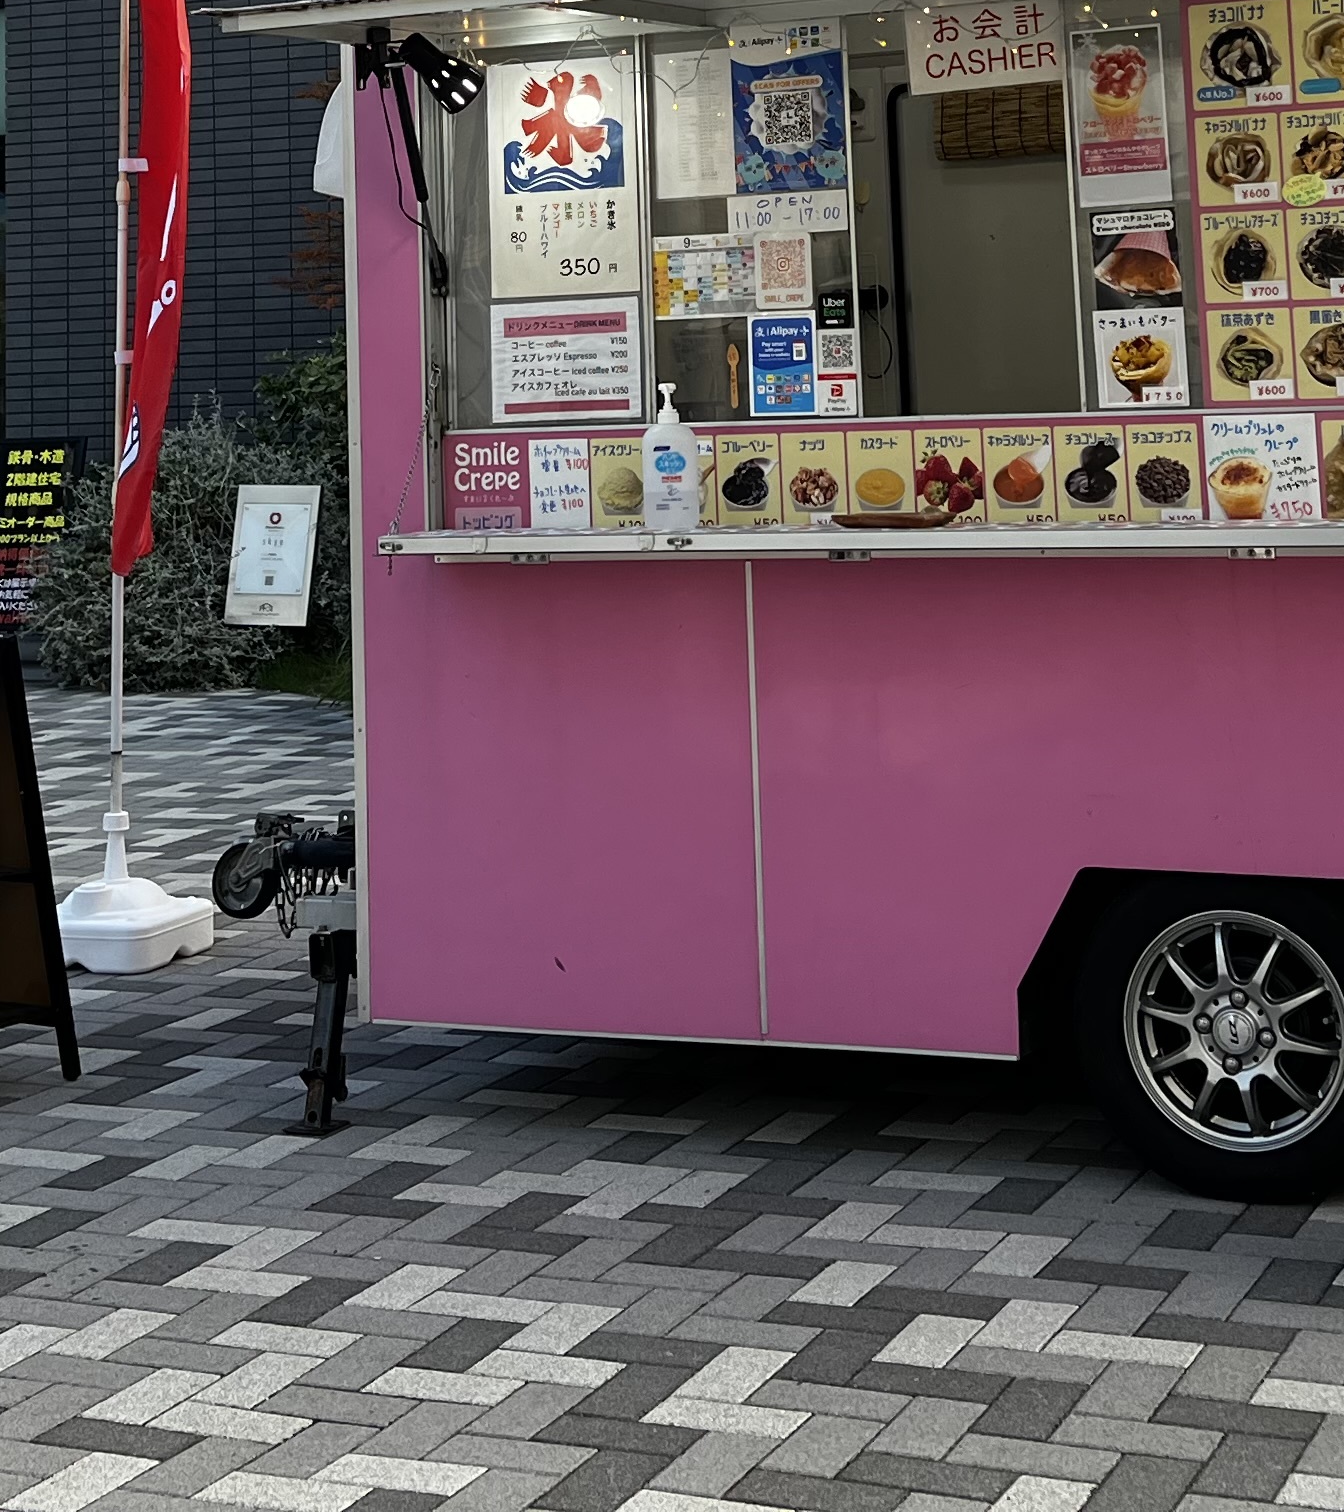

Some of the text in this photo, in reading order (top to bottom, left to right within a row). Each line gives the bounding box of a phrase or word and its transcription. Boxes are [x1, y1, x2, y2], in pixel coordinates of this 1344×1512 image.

[1208, 4, 1265, 24] チョコバナナ
[932, 2, 1045, 44] お会計
[925, 41, 1058, 80] CASHIER
[1254, 90, 1283, 102] ¥600
[521, 70, 608, 167] 氷
[1204, 118, 1267, 135] キャラメルバナナ
[1241, 187, 1270, 199] ¥600
[756, 194, 814, 209] OPEN
[552, 203, 560, 238] マンゴー
[577, 201, 585, 228] メロン
[1204, 212, 1279, 230] ブルーベリーレアチーズ
[510, 231, 527, 243] 80
[540, 204, 549, 258] ブルーハワイ
[559, 257, 601, 277] 350
[1251, 285, 1280, 297] ¥700
[822, 297, 846, 307] Uber
[823, 307, 846, 317] Eats
[1098, 315, 1177, 330] さつまいもバター
[770, 326, 799, 337] Alipay
[511, 340, 544, 350] コーヒー
[511, 352, 561, 363] エスプレッソ
[563, 352, 598, 362] Espresso
[511, 368, 570, 378] アイスコーヒー
[511, 380, 577, 392] アイスカフェオレ
[1256, 384, 1286, 396] ¥600
[860, 436, 899, 450] カスタード
[925, 436, 971, 448] ストロベリー
[987, 433, 1051, 448] キャラメルソース
[1065, 432, 1115, 446] チョコソース
[1131, 430, 1193, 444] チョコチップス
[1264, 436, 1299, 452] クレープ
[592, 444, 642, 457] アイスクリー
[722, 440, 774, 453] ブルーベリー
[799, 439, 825, 451] ナッツ
[454, 441, 520, 468] Smile
[454, 467, 521, 492] Crepe
